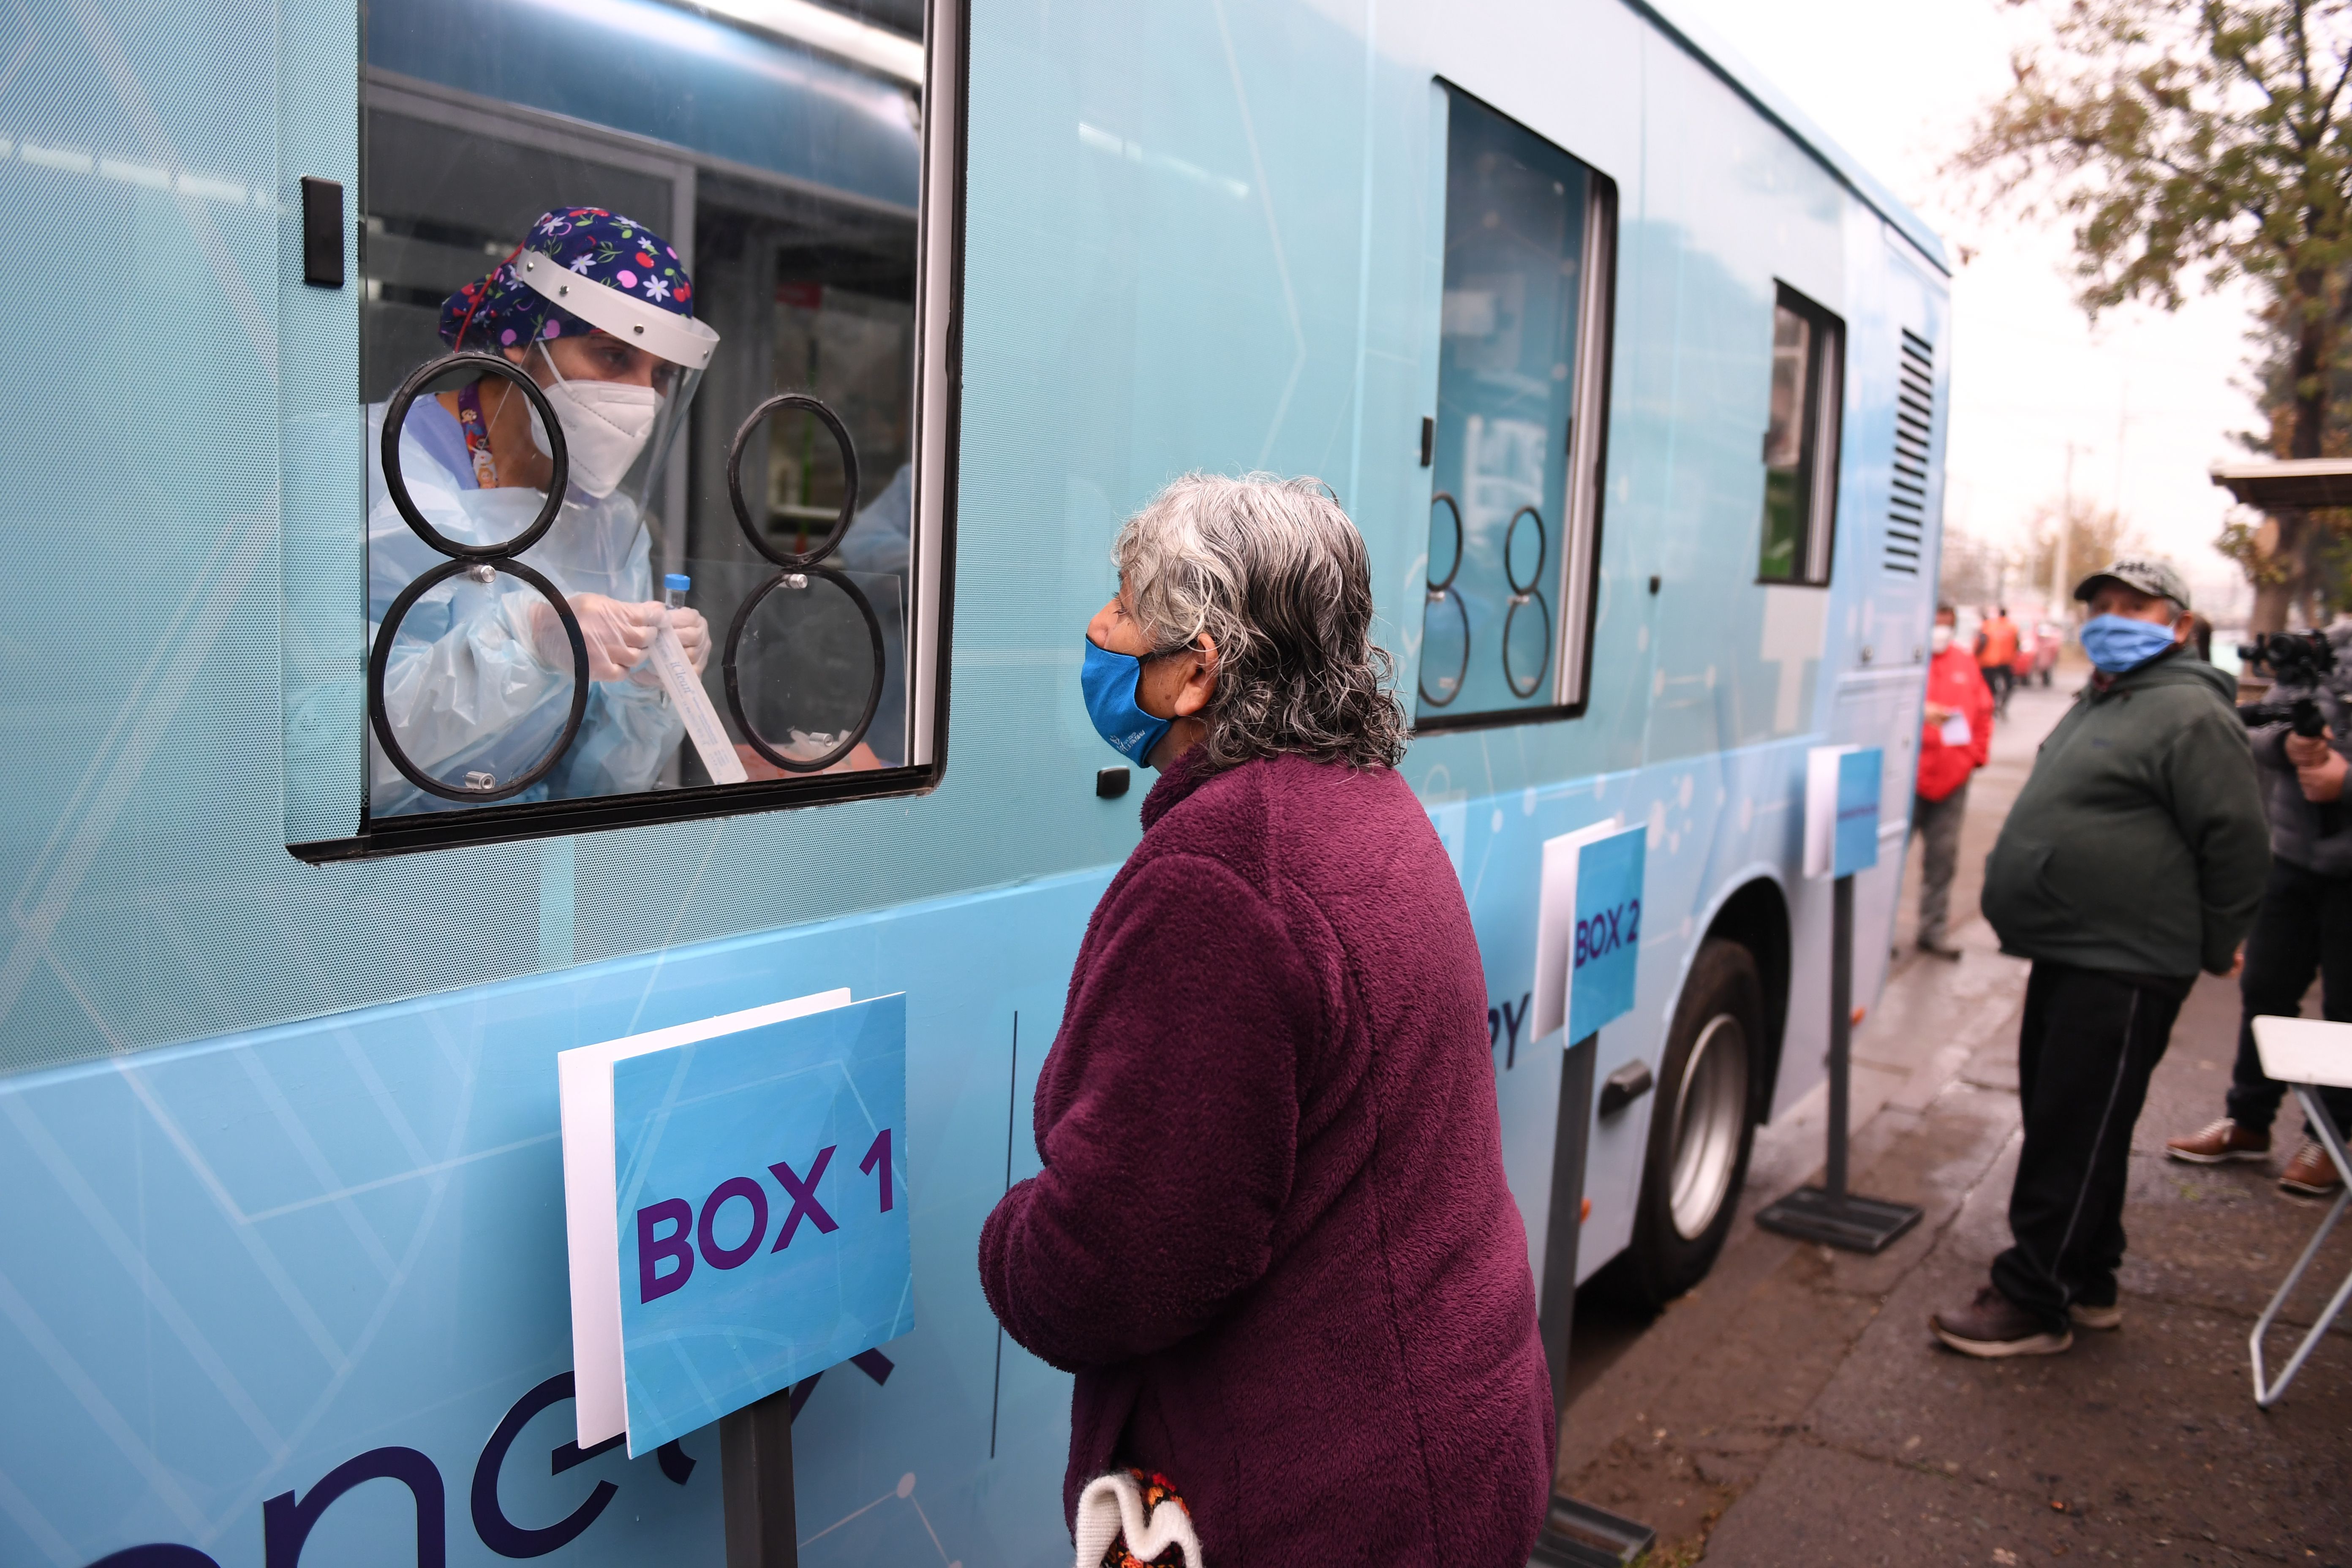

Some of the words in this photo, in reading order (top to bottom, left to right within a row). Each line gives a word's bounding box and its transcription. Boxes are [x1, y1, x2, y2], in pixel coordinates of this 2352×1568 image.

[1576, 904, 1623, 968] BOX
[1627, 899, 1640, 943] 2
[637, 1144, 839, 1305] BOX
[859, 1128, 893, 1213] 1
